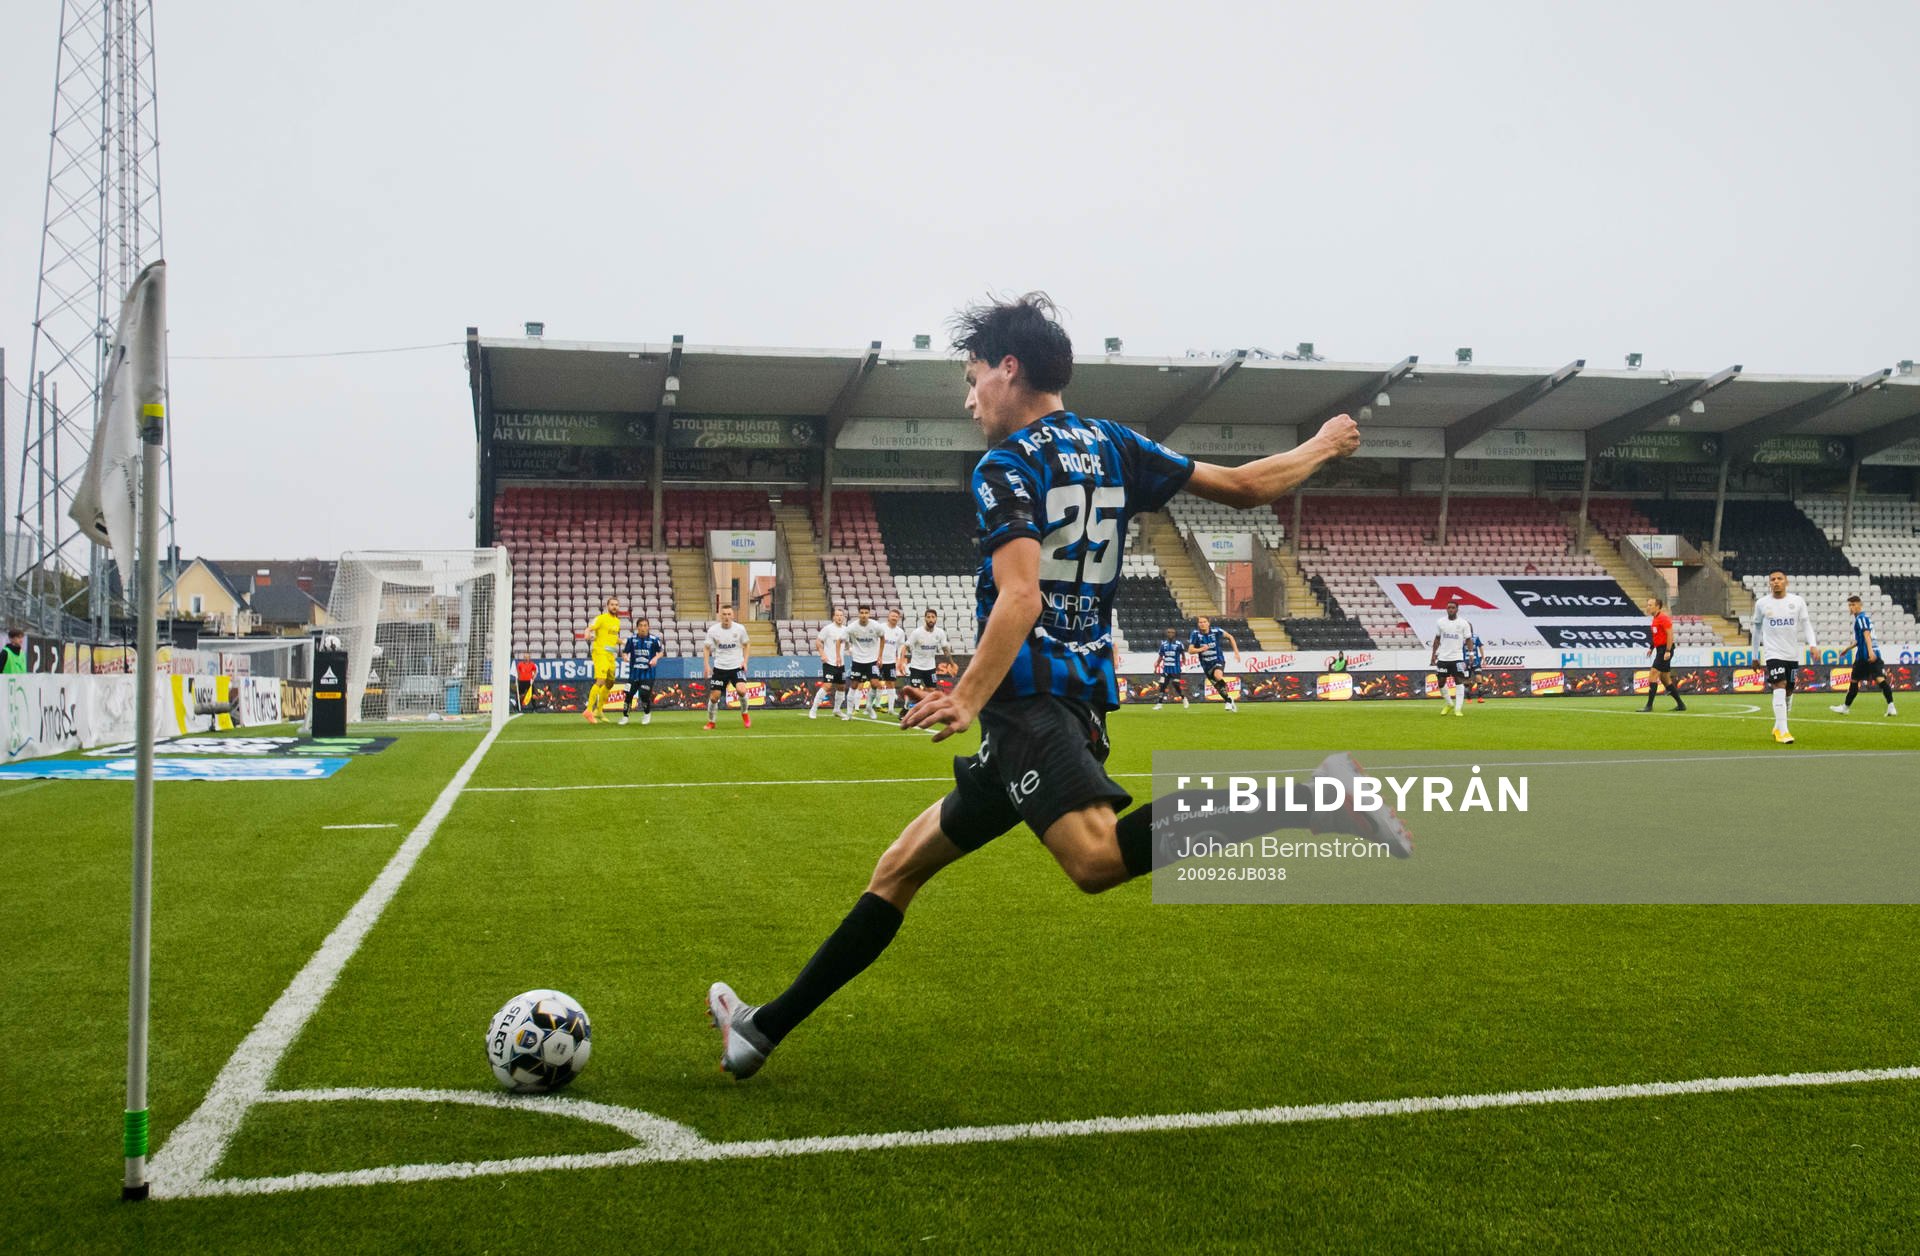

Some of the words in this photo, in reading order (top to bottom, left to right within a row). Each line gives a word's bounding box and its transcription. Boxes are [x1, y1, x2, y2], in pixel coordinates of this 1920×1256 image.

[727, 432, 780, 444] PASSION
[1040, 484, 1126, 584] 25
[1512, 590, 1628, 607] Printoz
[1559, 629, 1647, 641] ÖREBRO
[493, 1005, 521, 1060] SELECT
